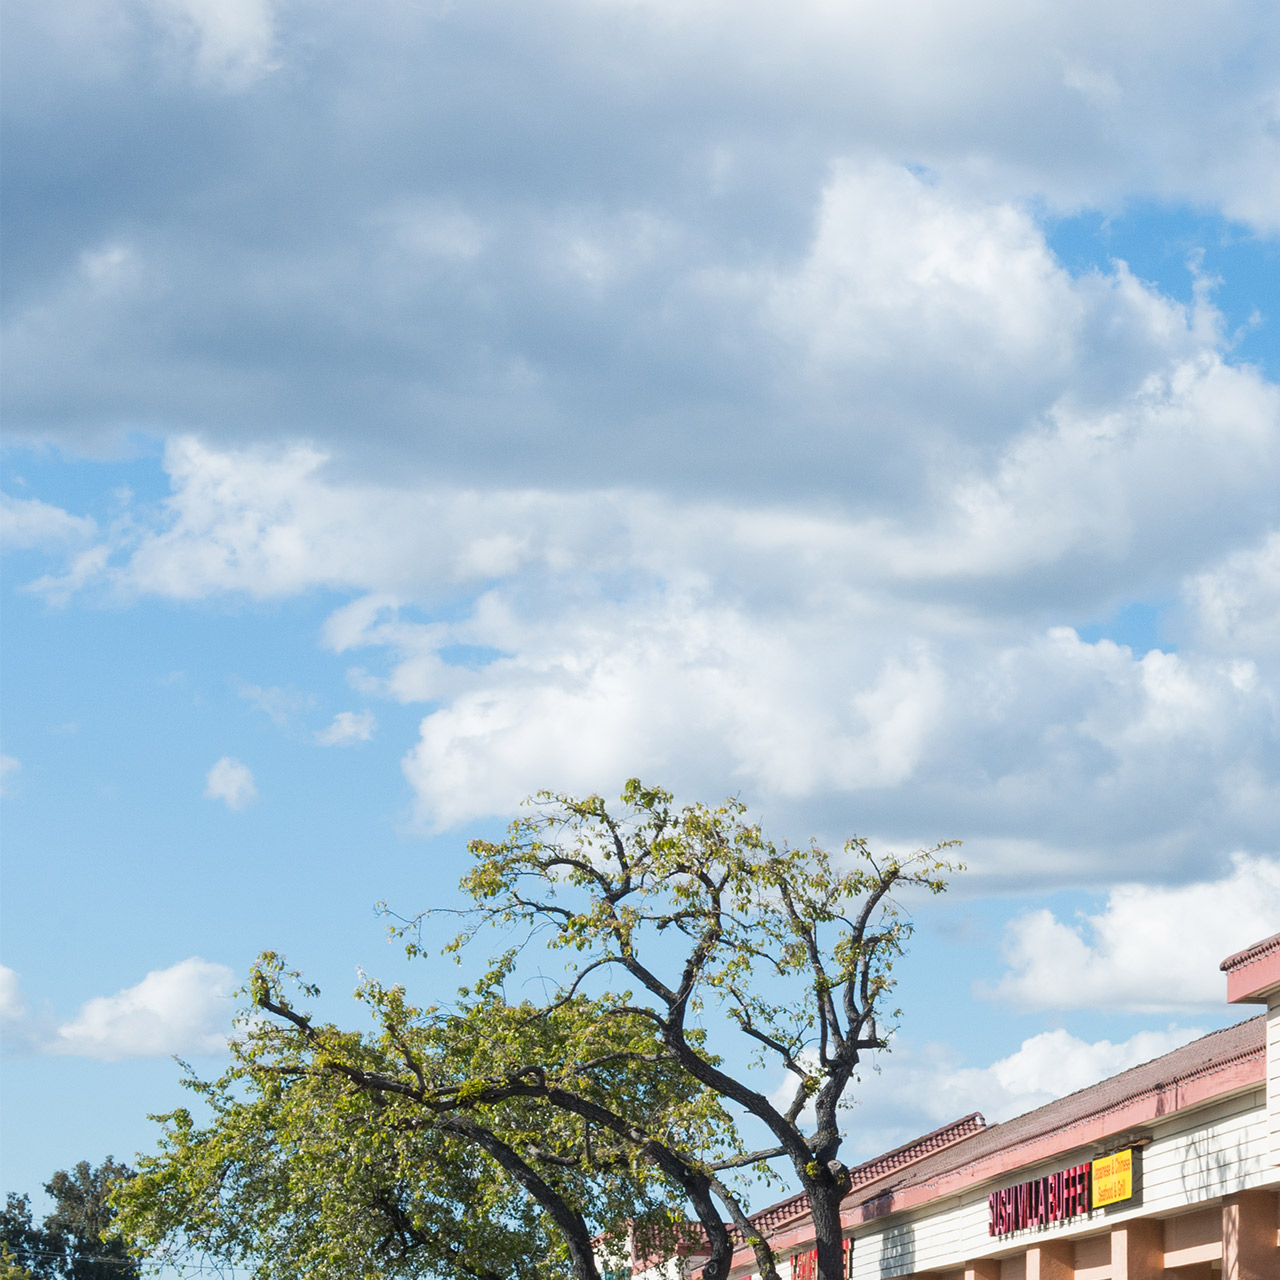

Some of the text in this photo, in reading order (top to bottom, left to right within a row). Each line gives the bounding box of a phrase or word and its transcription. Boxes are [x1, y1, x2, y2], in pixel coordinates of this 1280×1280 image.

[988, 1161, 1090, 1237] SUSHI VILLA BUFFET
